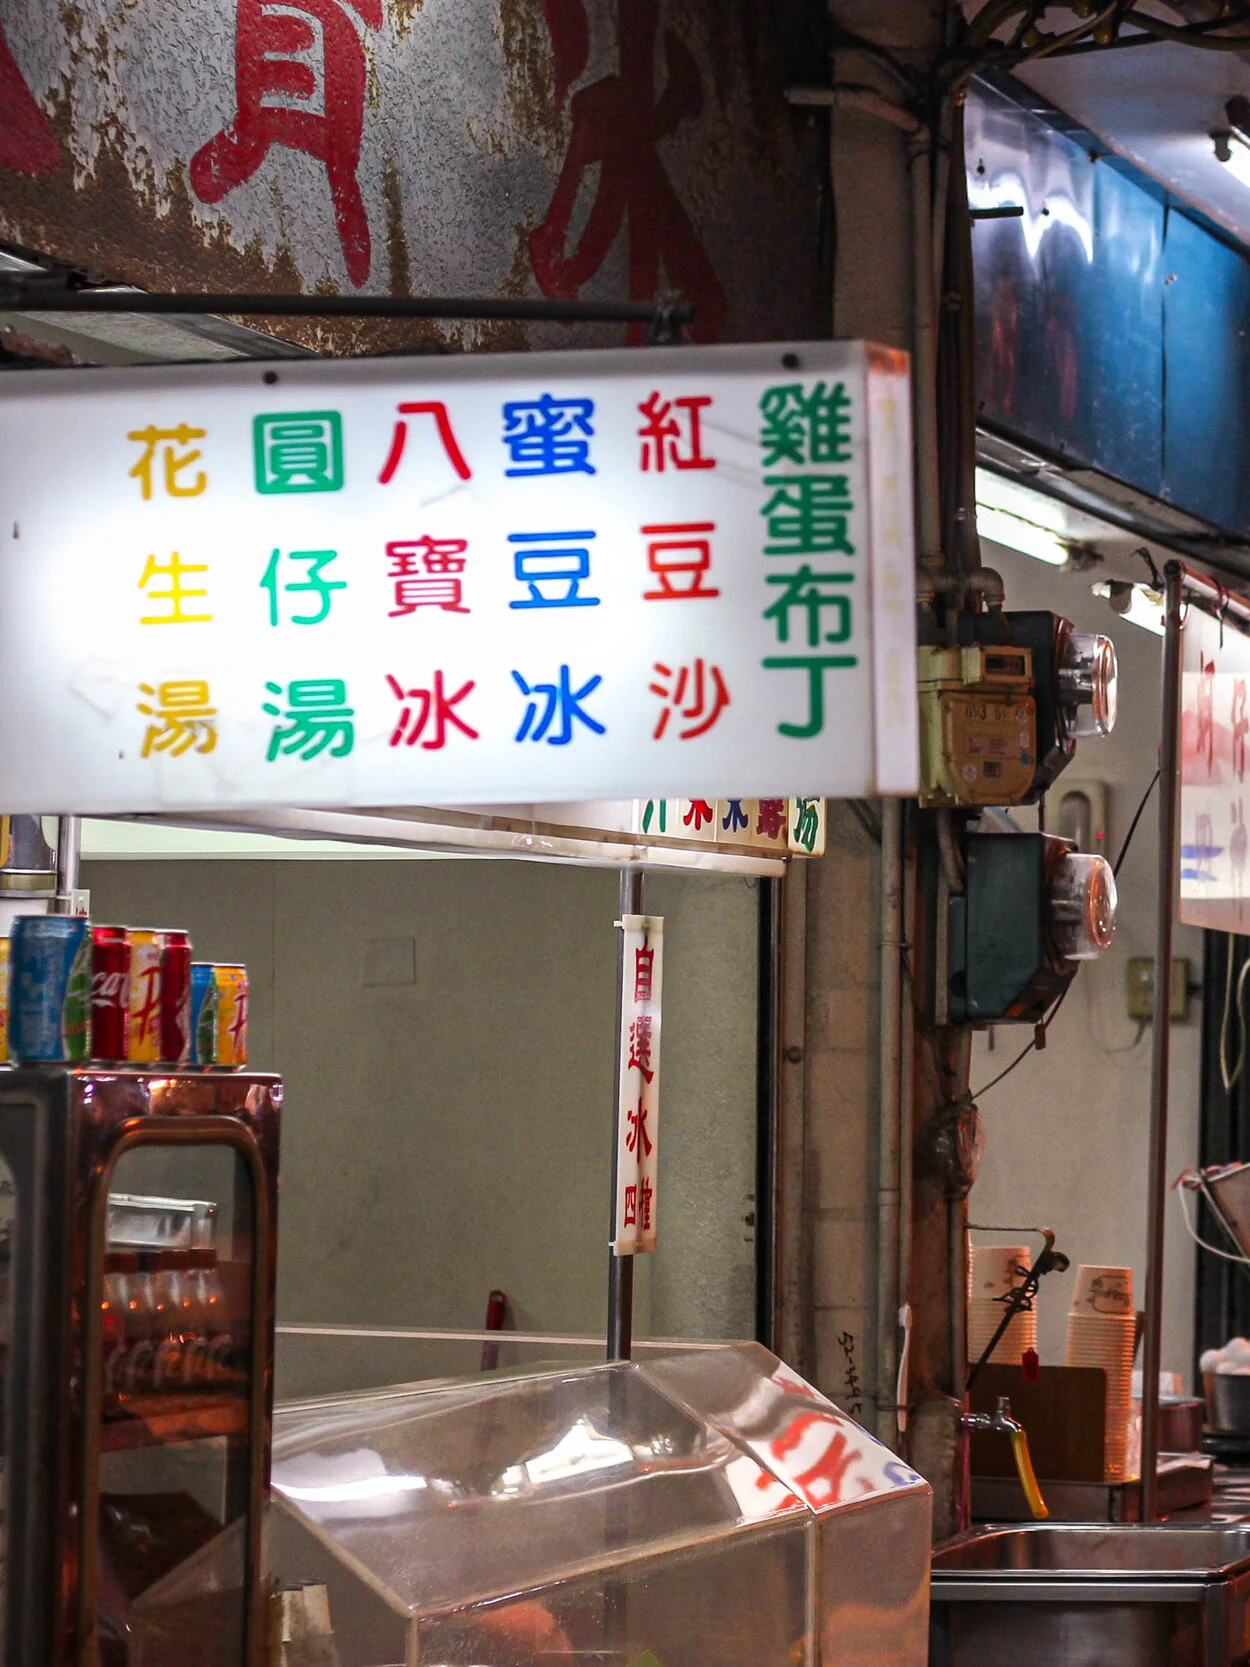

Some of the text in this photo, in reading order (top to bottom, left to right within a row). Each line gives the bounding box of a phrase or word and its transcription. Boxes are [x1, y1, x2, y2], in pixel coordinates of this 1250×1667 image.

[127, 423, 219, 760] 花生湯
[252, 409, 355, 763] 圓仔湯
[378, 400, 481, 751] 八寶冰
[501, 393, 606, 747] 蜜豆冰
[636, 391, 731, 741] 紅豆沙
[759, 382, 859, 741] 雞蛋布丁
